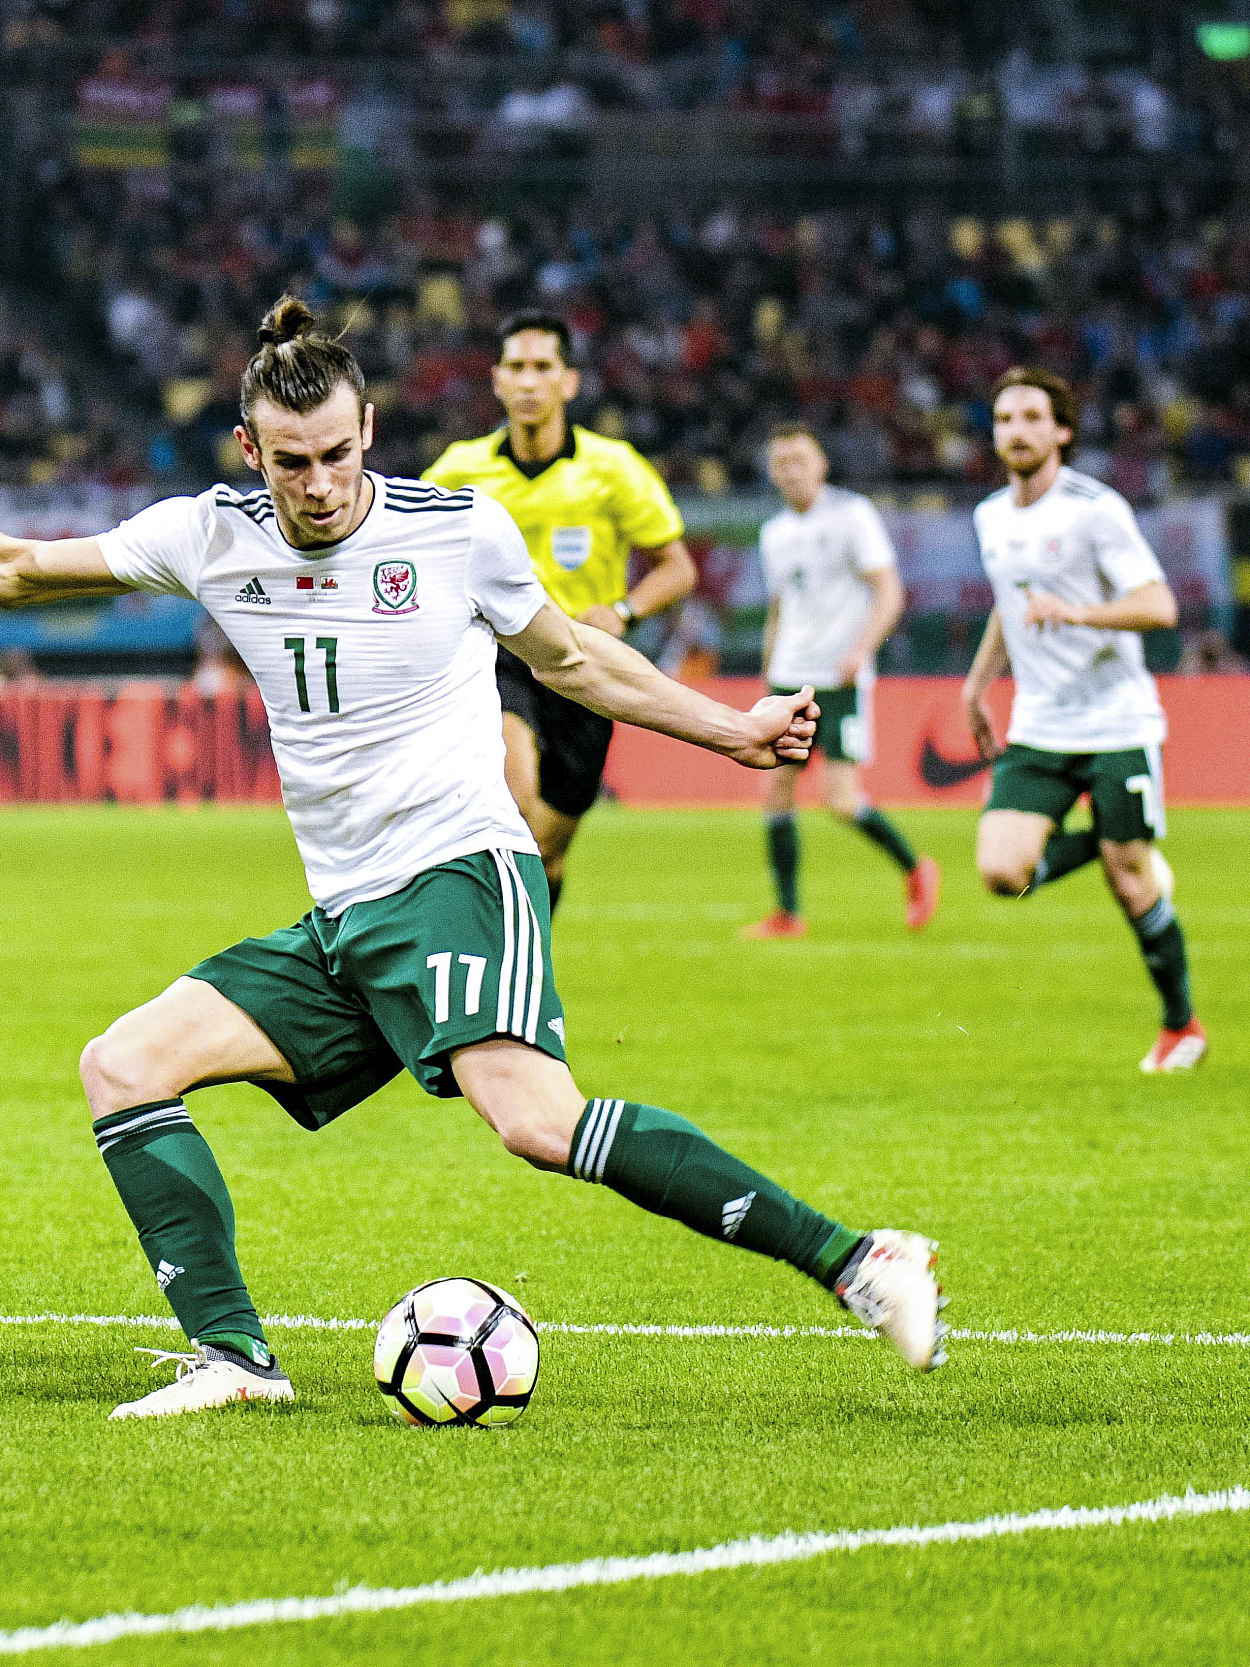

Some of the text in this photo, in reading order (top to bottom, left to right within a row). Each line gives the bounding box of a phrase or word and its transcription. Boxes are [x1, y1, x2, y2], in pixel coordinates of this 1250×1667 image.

[234, 593, 272, 605] adidas
[284, 637, 340, 713] 11
[426, 951, 488, 1024] 11
